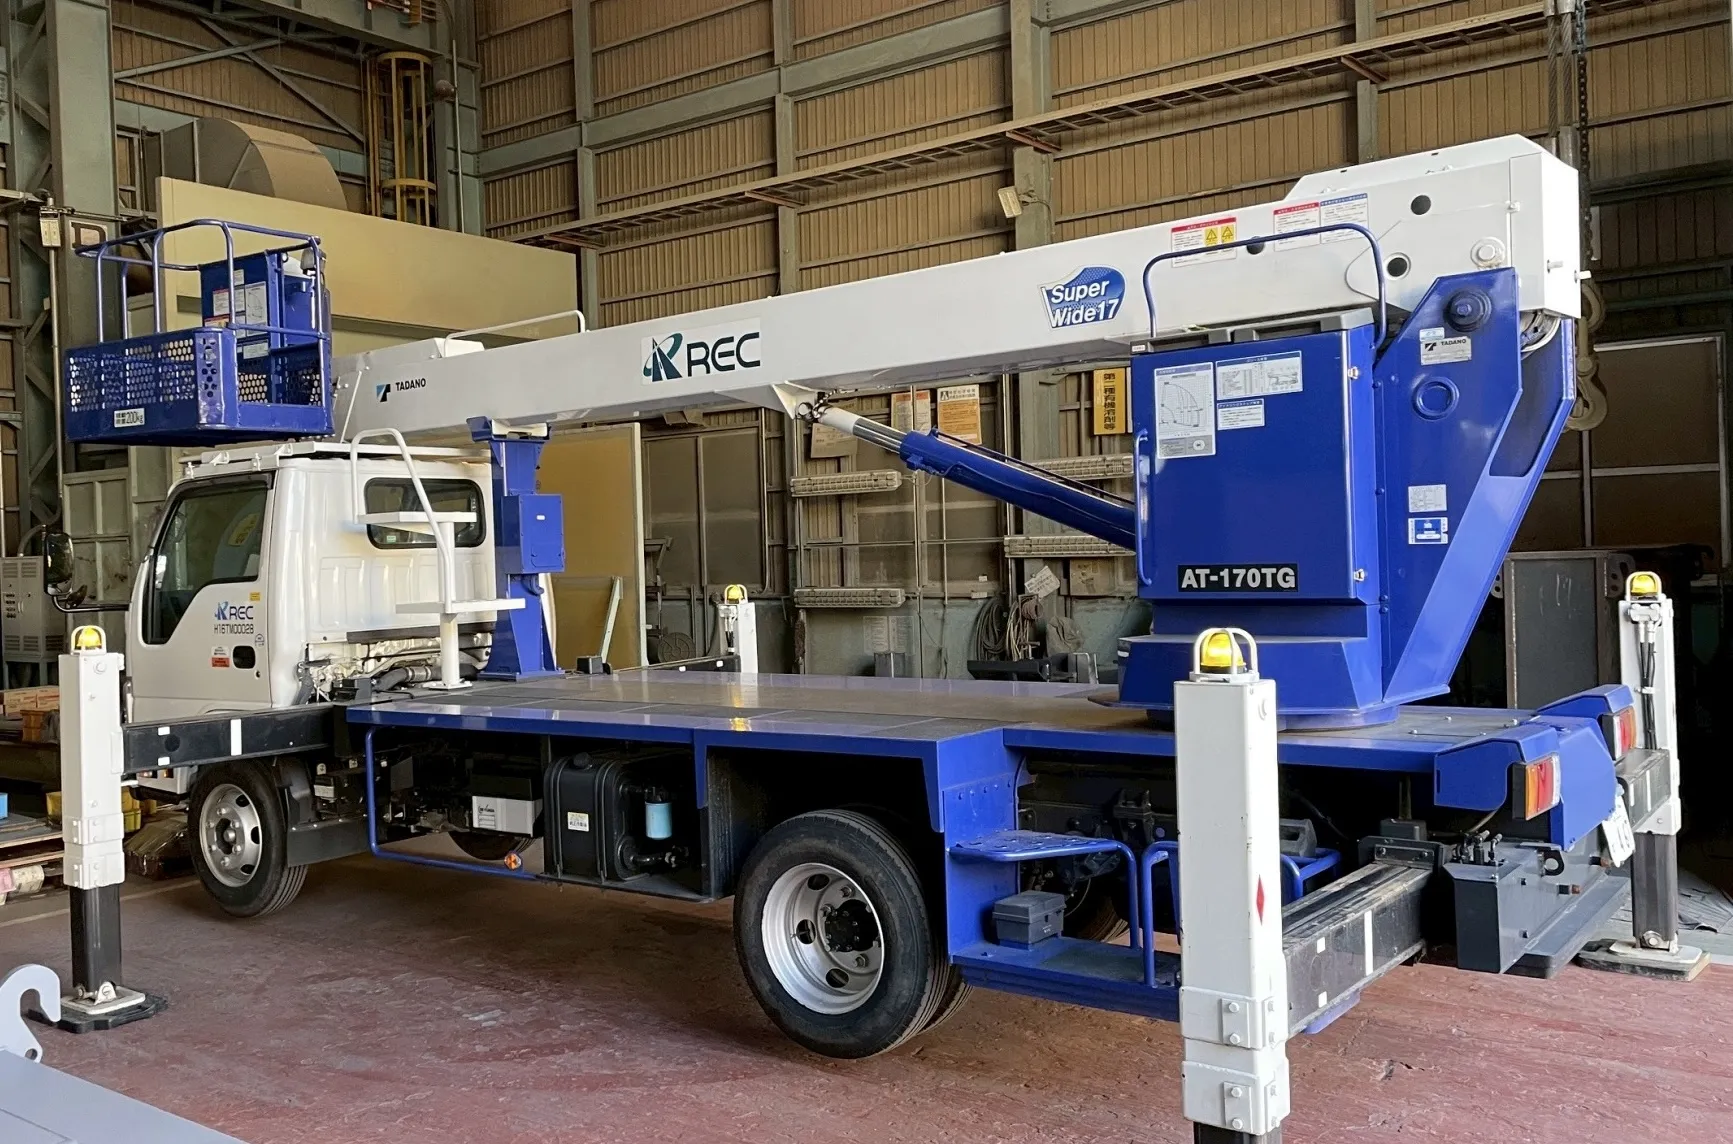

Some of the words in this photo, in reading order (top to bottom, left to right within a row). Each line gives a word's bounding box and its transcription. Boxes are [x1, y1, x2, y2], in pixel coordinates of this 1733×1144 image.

[1051, 280, 1110, 304] Super
[1041, 298, 1120, 328] Wide17
[1441, 338, 1467, 346] TADANO
[686, 331, 761, 378] REC
[395, 377, 427, 391] TADANO
[1181, 567, 1296, 589] AT-170TG
[229, 605, 254, 620] REC
